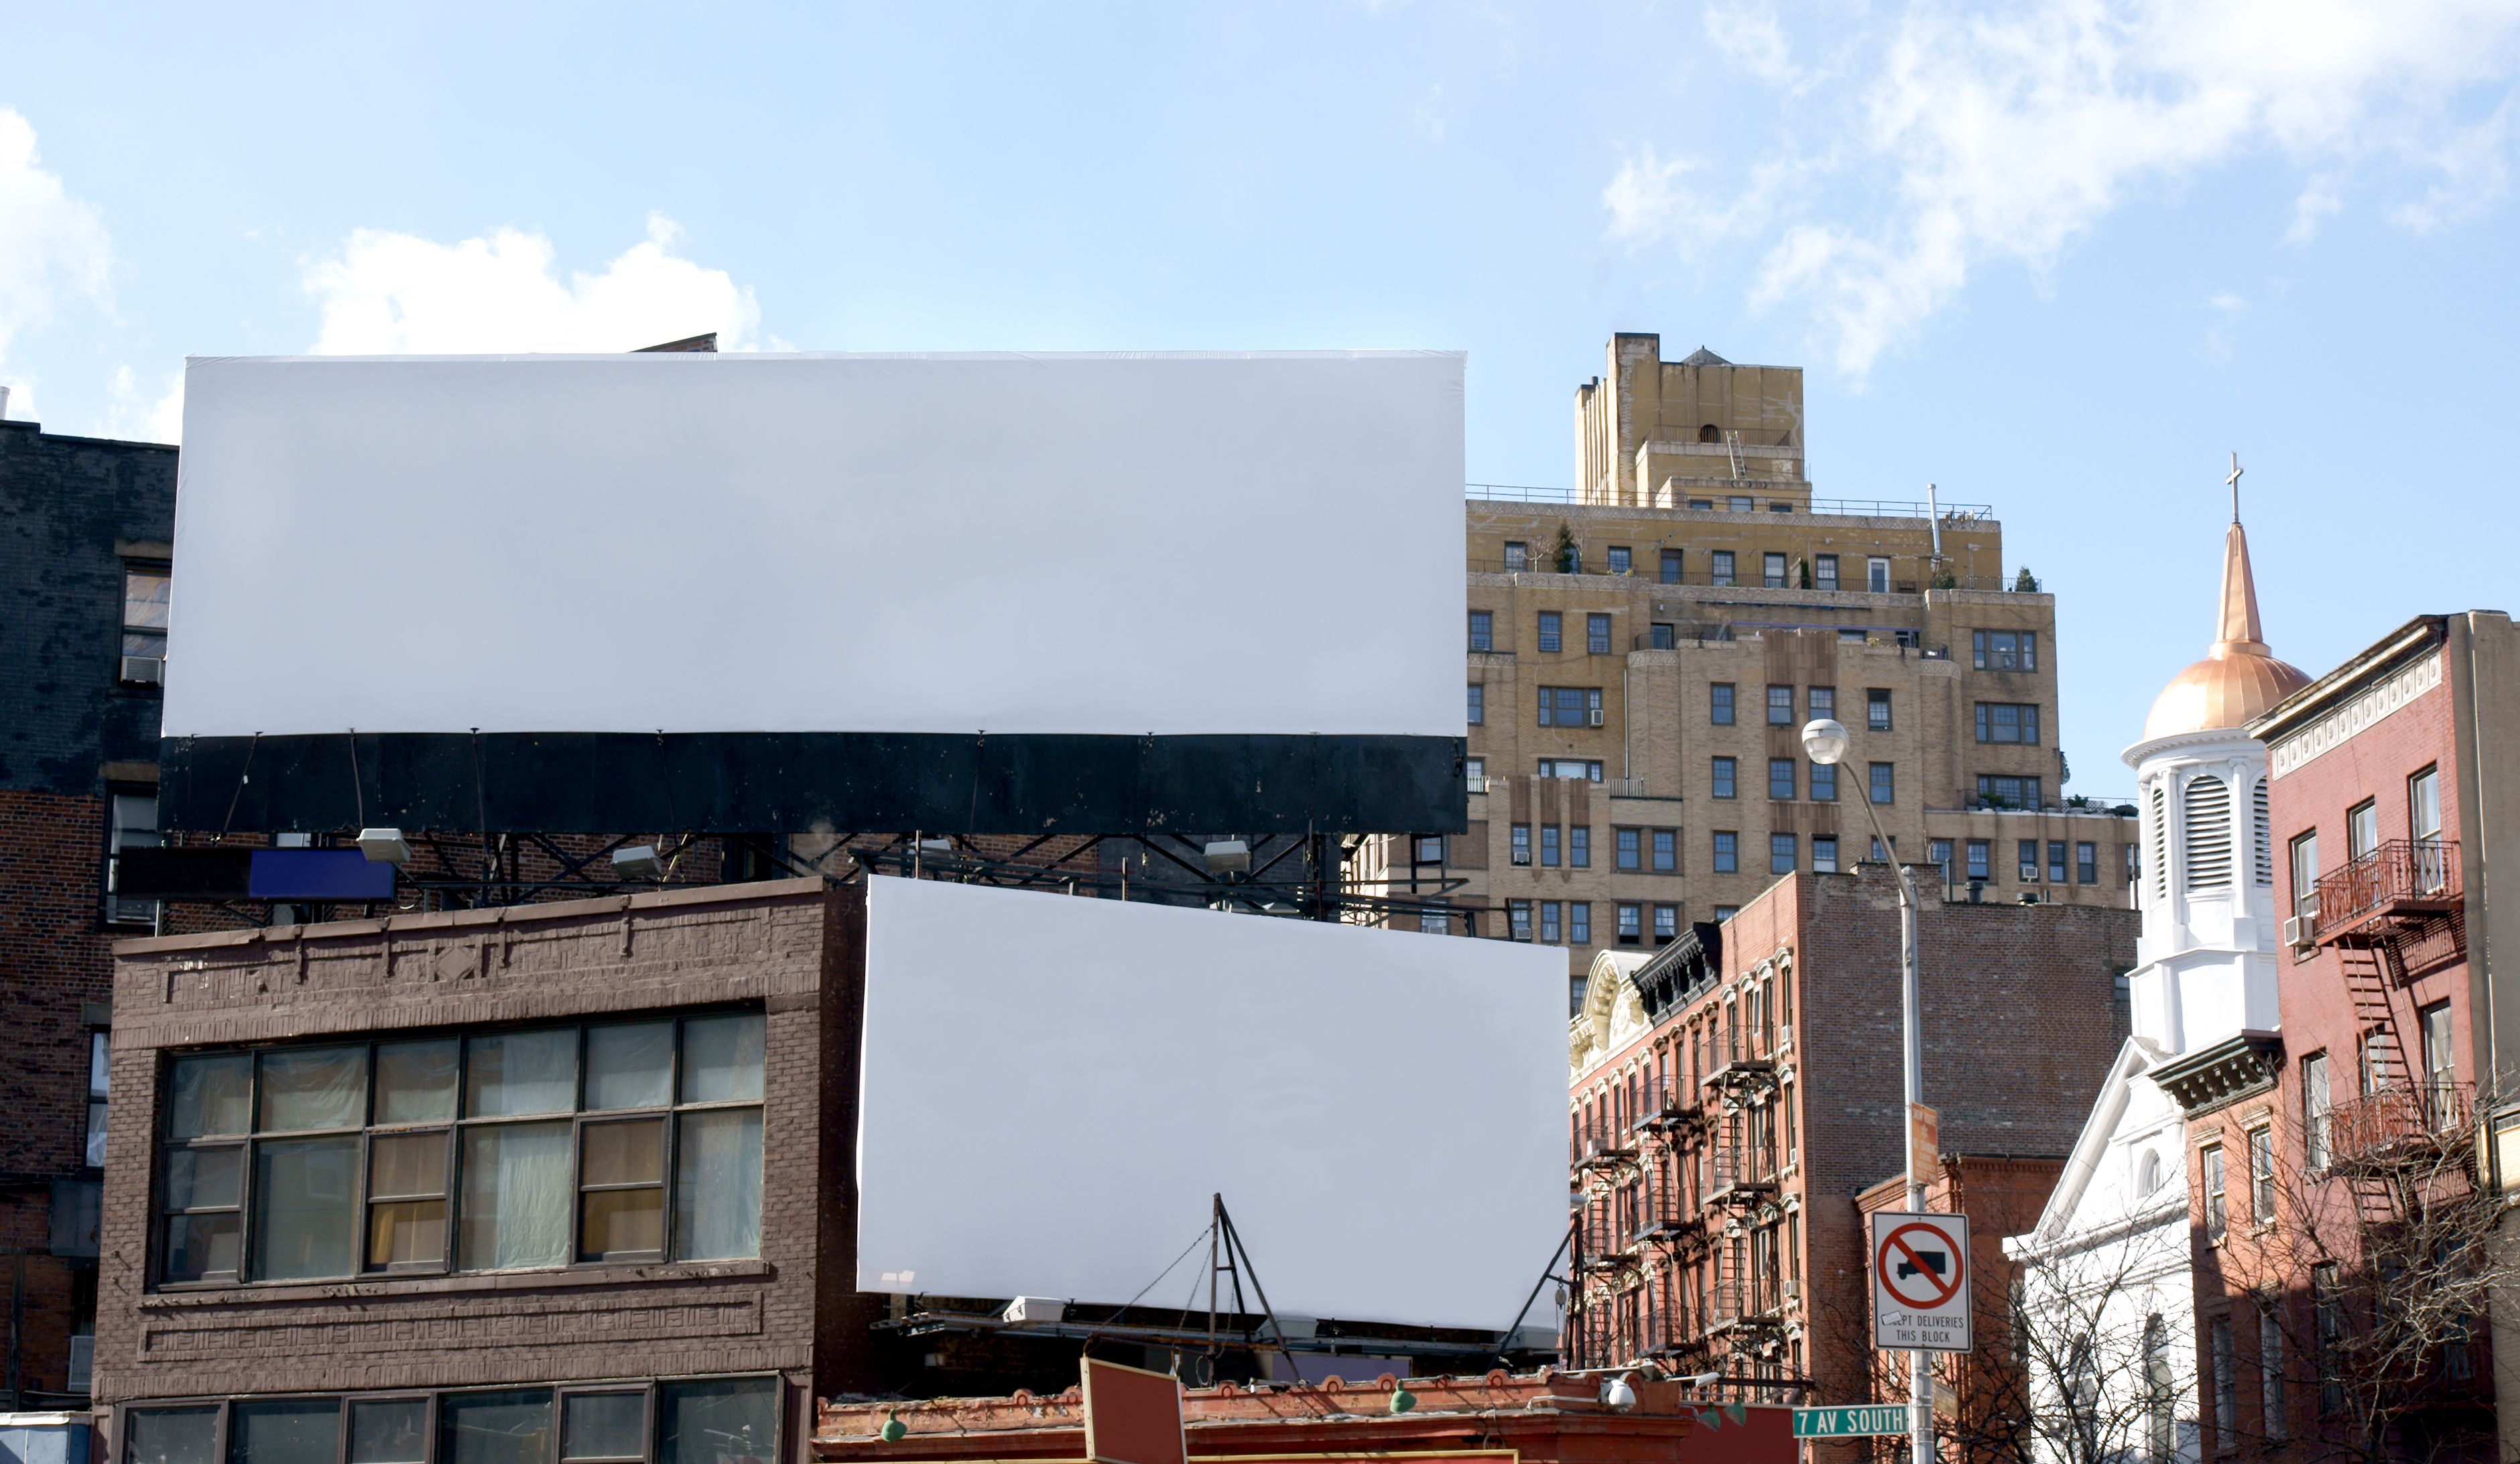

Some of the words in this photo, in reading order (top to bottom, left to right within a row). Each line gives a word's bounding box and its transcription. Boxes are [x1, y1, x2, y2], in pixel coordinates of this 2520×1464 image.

[1917, 1315, 1964, 1328] DELIVERIES
[1897, 1329, 1915, 1341] THIS
[1922, 1331, 1950, 1343] BLOCK
[1798, 1412, 1808, 1434] 7
[1817, 1410, 1837, 1433] AV
[1847, 1408, 1903, 1432] SOUTH
